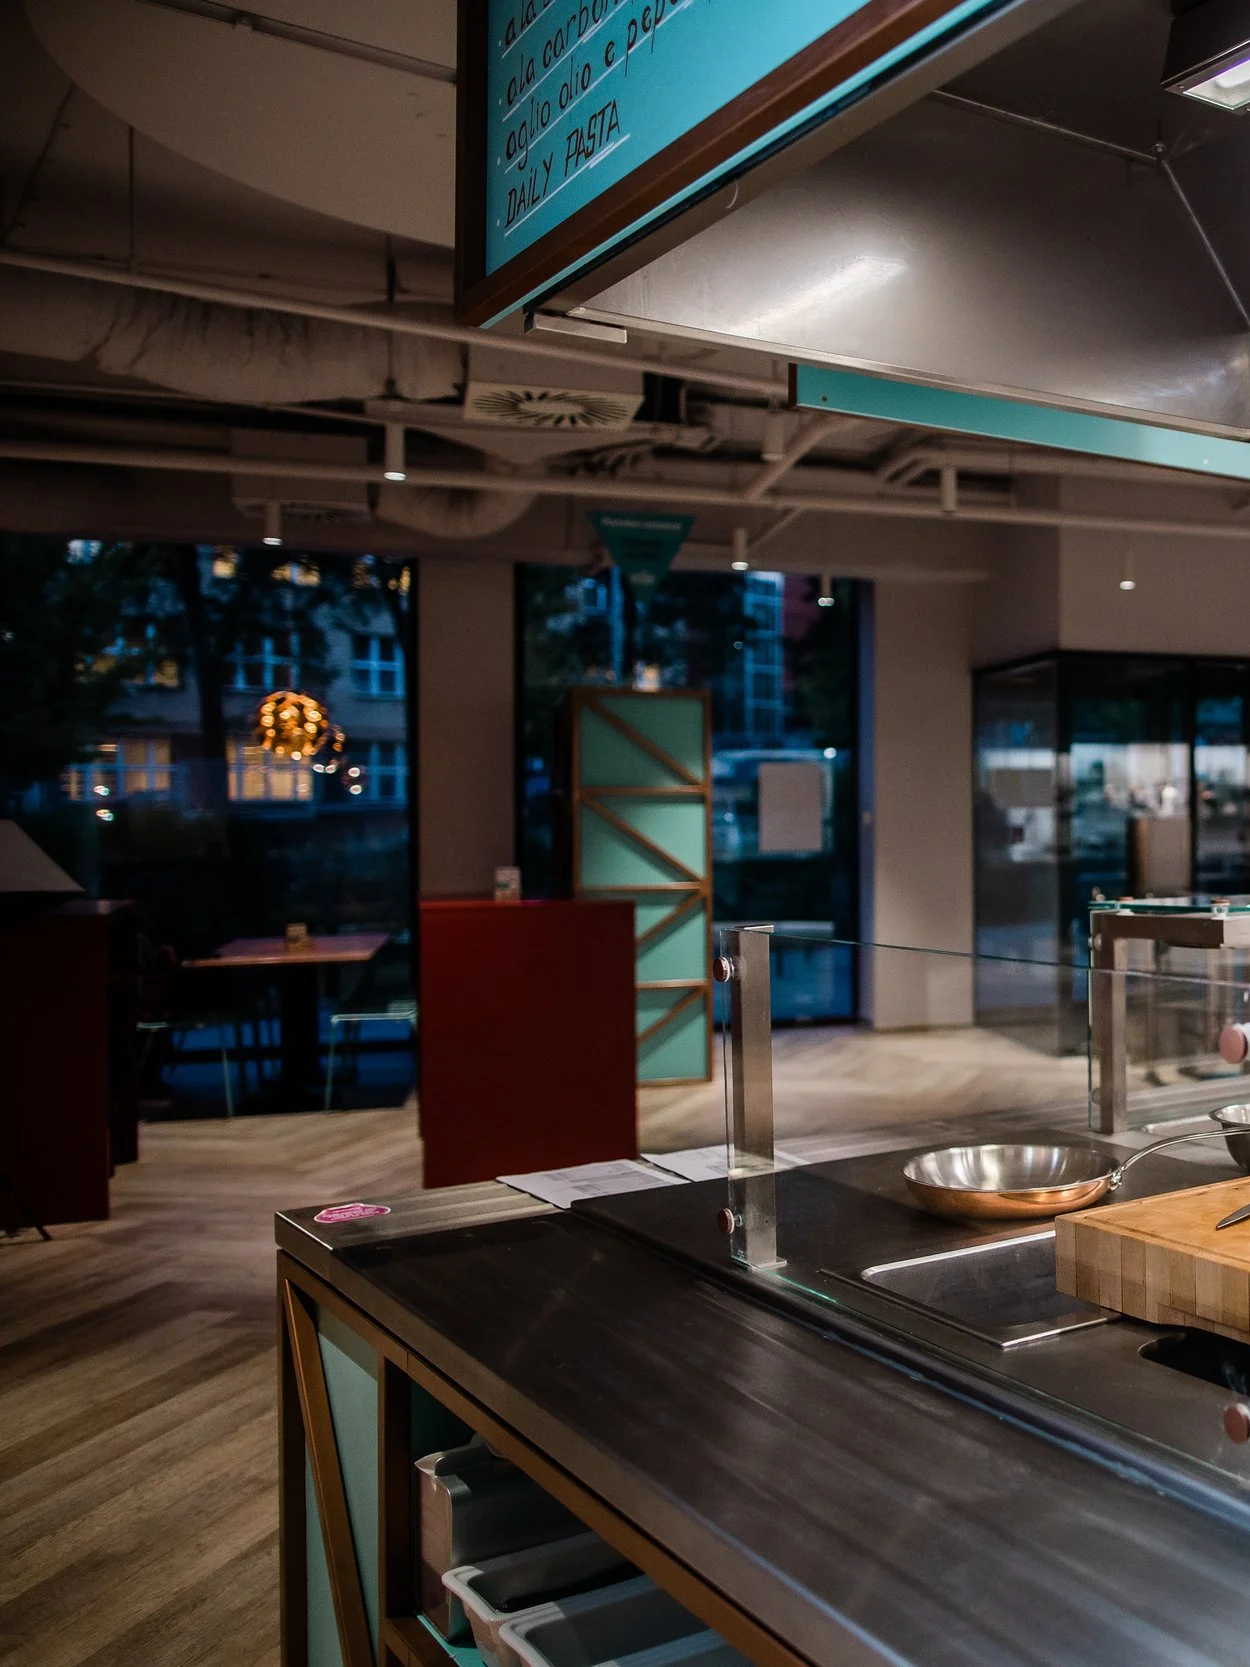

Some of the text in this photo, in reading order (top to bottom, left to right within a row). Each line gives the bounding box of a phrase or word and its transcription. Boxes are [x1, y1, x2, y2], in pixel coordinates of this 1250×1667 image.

[505, 95, 551, 171] aglio
[559, 55, 592, 110] olio
[604, 40, 615, 67] e
[507, 54, 536, 106] ala
[564, 98, 621, 178] PASTA
